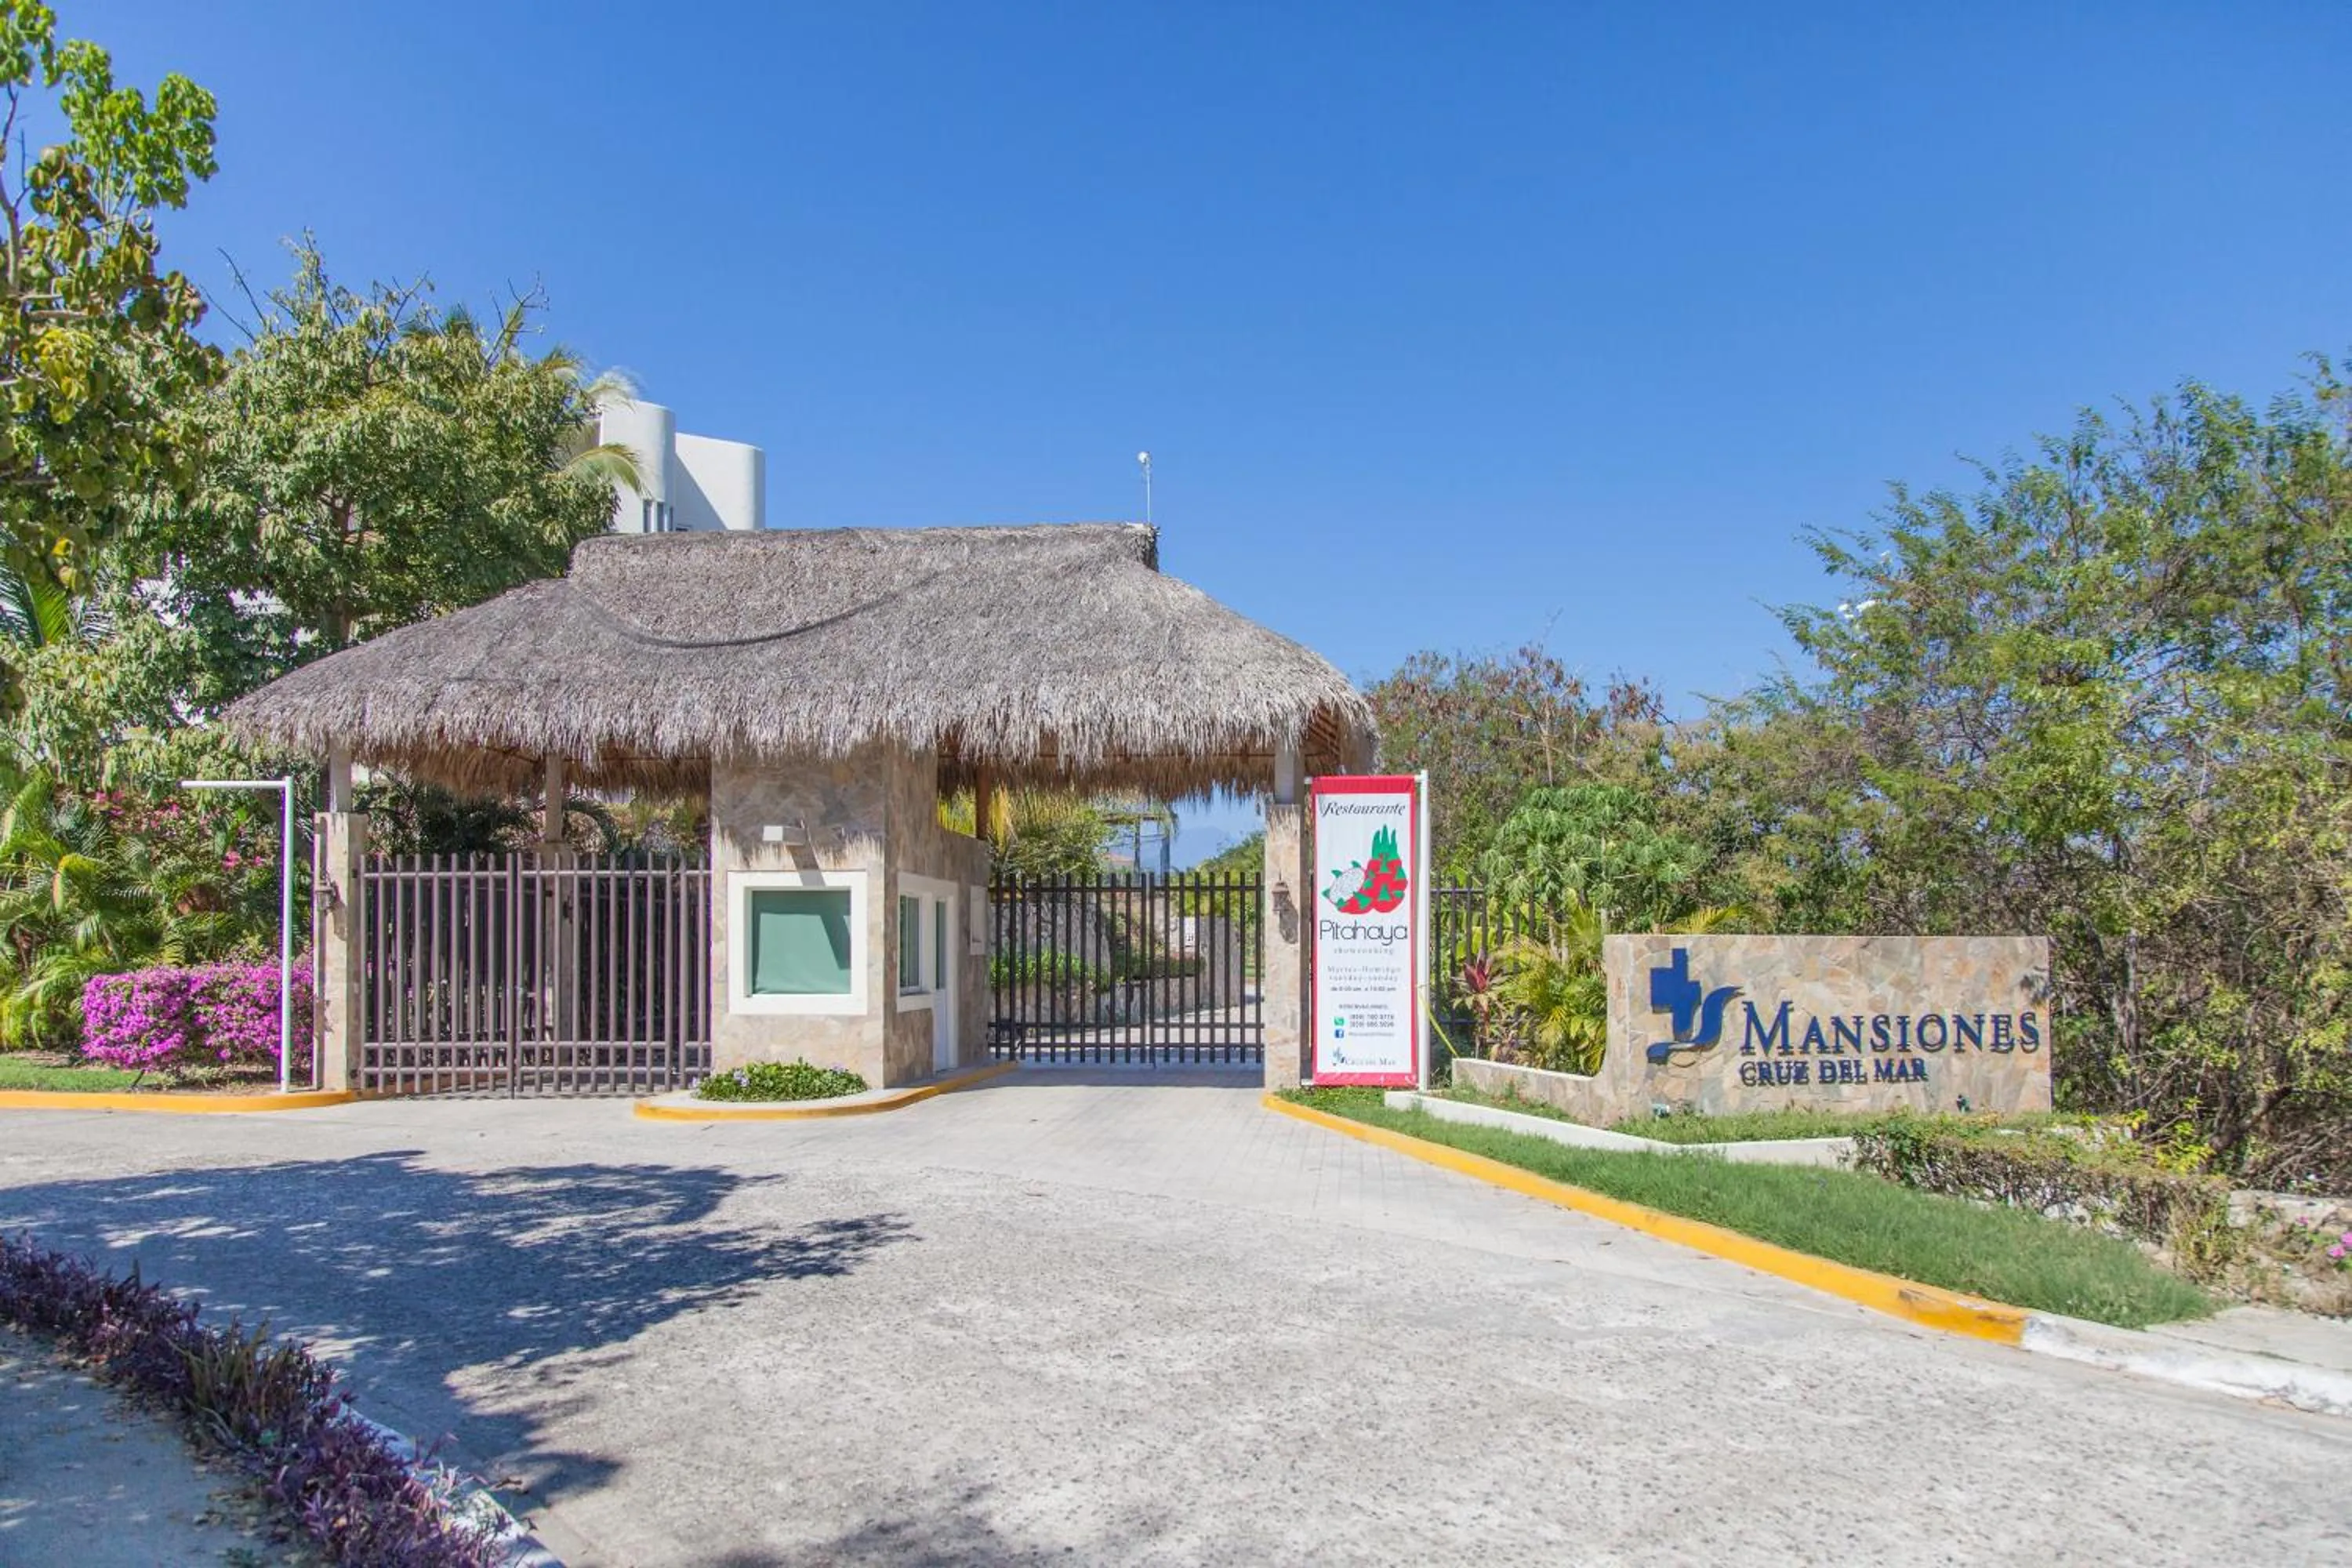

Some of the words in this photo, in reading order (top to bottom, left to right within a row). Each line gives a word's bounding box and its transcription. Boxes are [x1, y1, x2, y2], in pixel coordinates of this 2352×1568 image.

[1323, 802, 1406, 817] Restaurante
[1319, 919, 1408, 946] Pitahaya
[1740, 1000, 2040, 1055] MANSIONES
[1740, 1061, 1809, 1087] CRUZ
[1818, 1059, 1868, 1085] DEL
[1874, 1058, 1929, 1083] MAR
